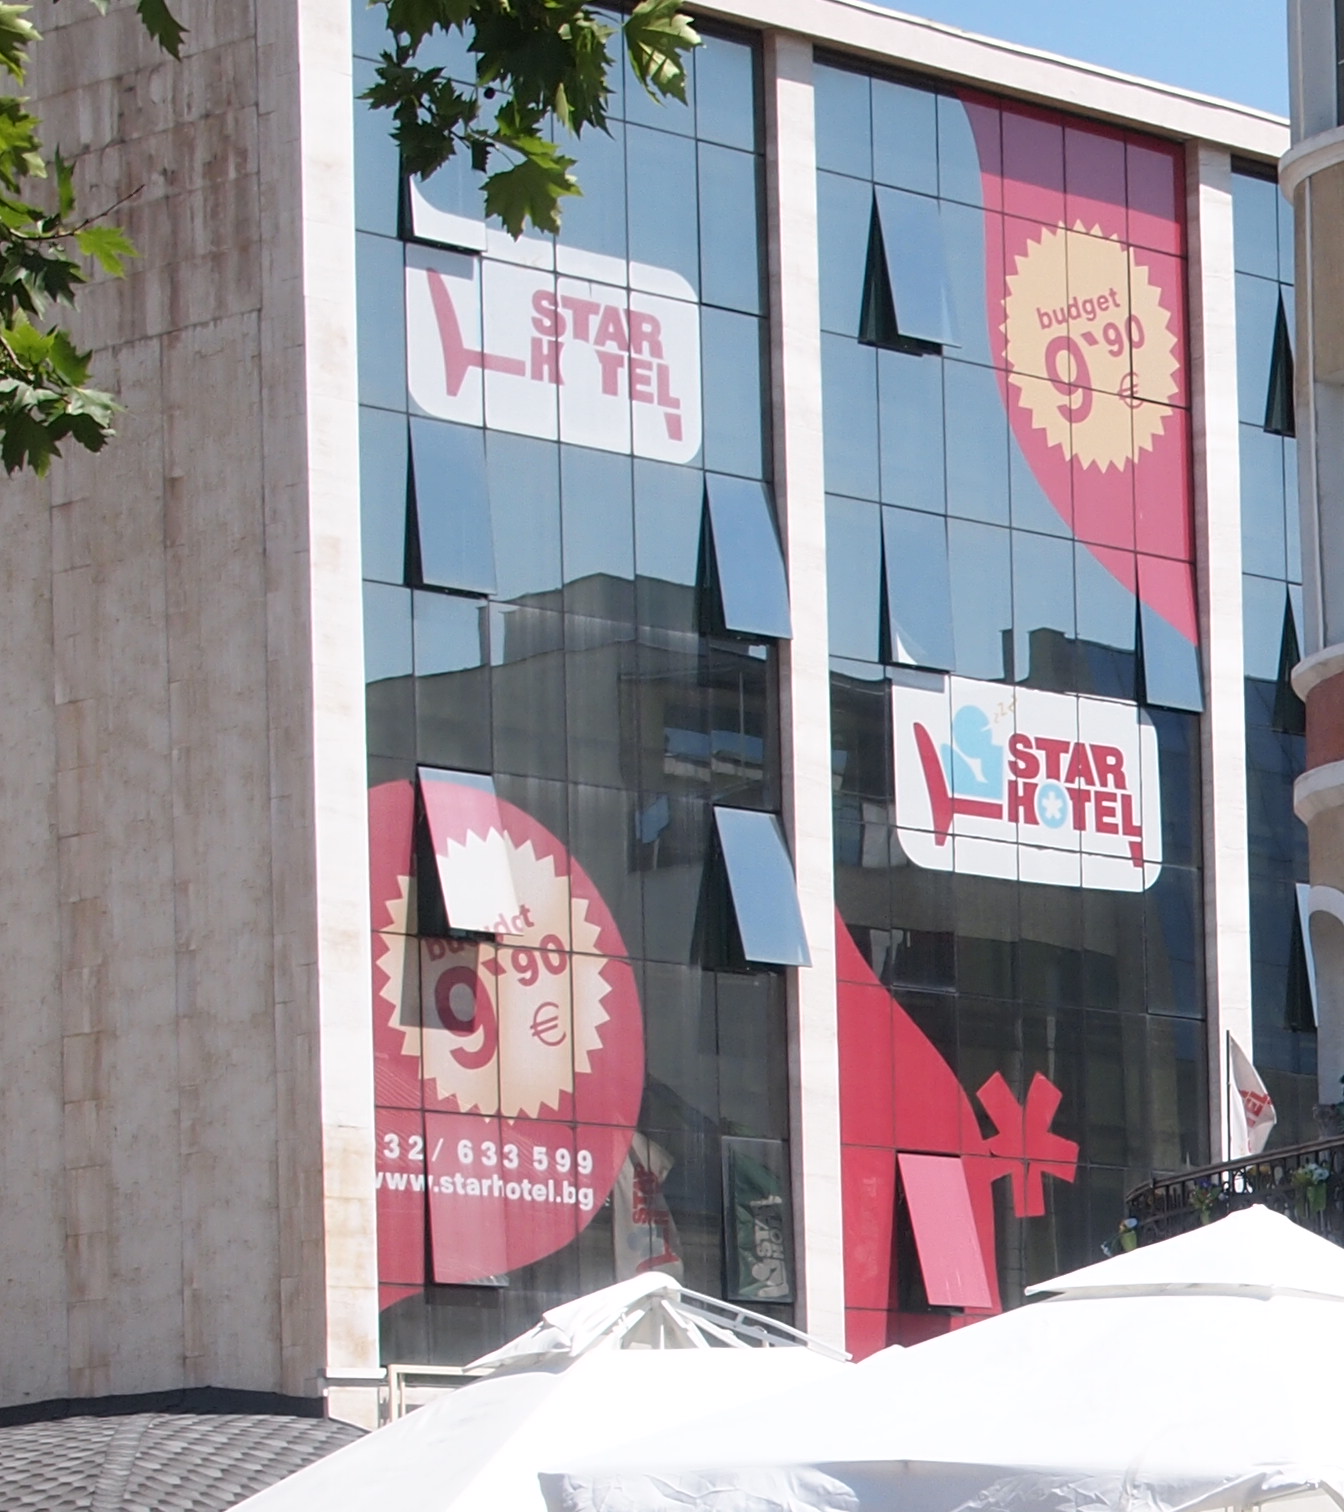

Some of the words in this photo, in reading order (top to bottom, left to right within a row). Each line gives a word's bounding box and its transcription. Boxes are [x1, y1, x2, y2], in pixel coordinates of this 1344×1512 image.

[531, 289, 664, 359] STAR
[1036, 287, 1121, 330] budget
[531, 336, 681, 410] HTEL
[1008, 733, 1128, 790] STAR
[1008, 779, 1143, 837] HOTEL
